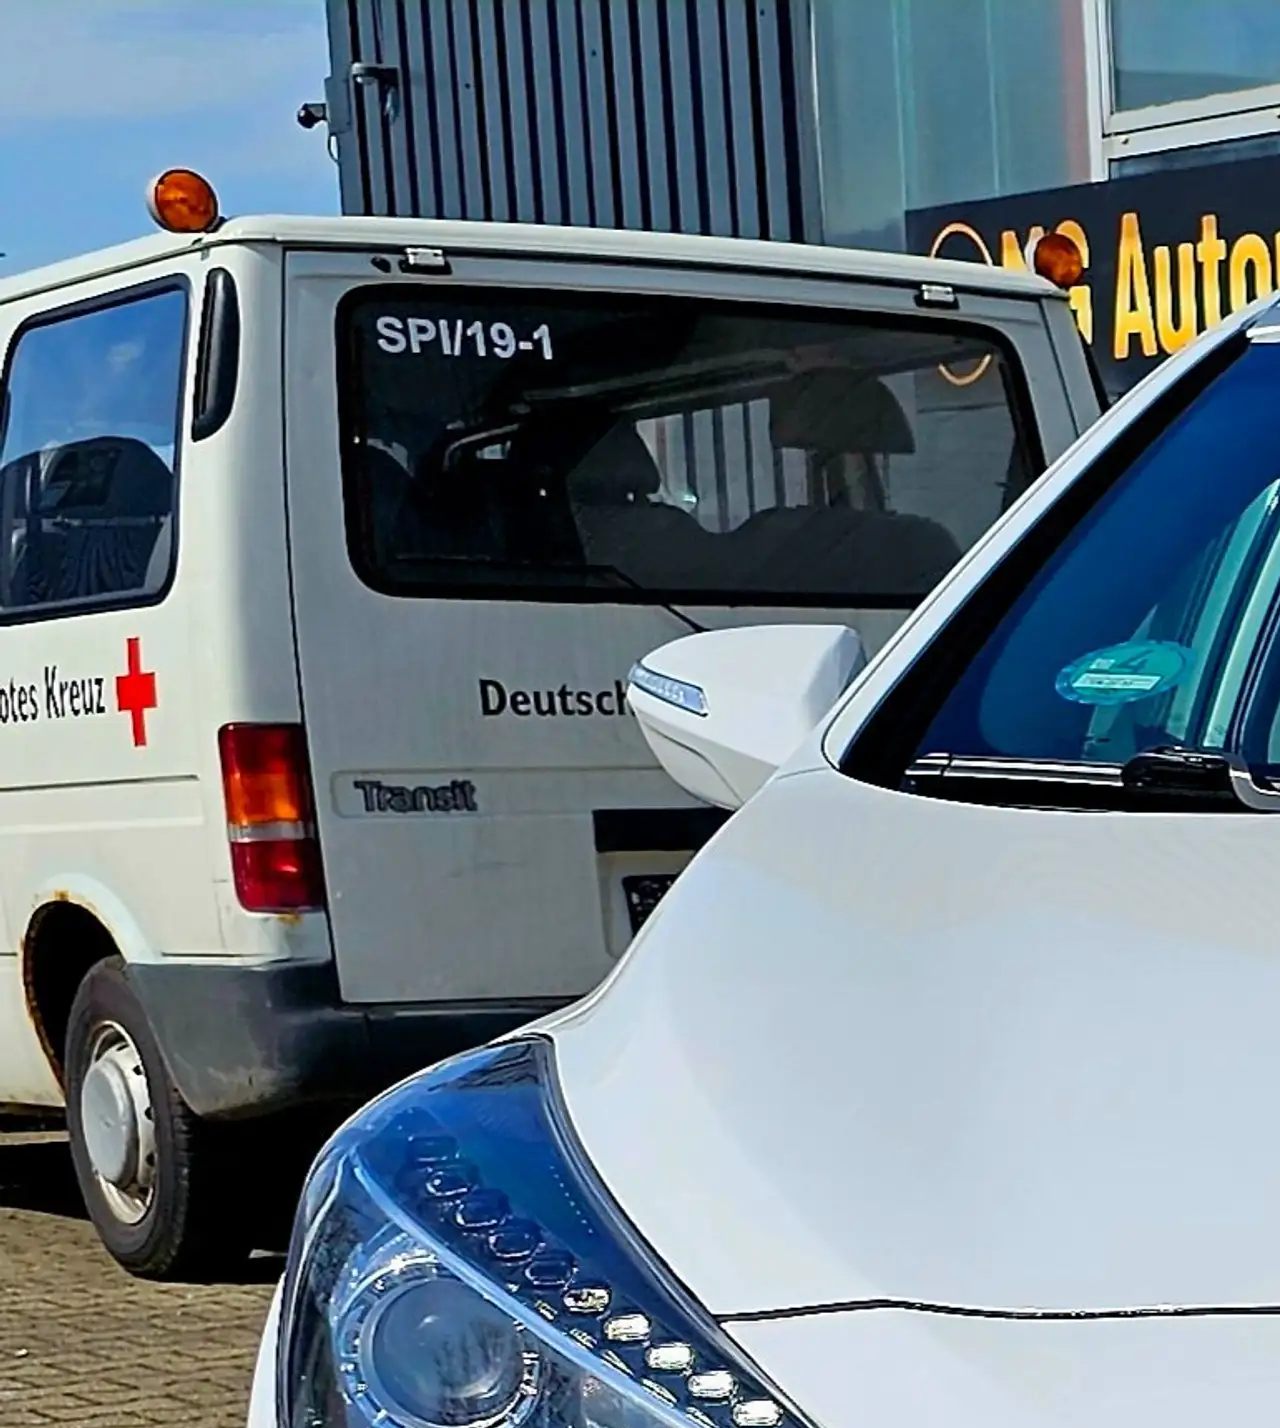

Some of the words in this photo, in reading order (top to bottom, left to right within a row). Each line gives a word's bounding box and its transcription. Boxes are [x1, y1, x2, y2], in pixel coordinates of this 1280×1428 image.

[376, 315, 553, 360] SPI/19-1
[44, 665, 106, 719] Kreuz
[353, 779, 479, 814] Transit
